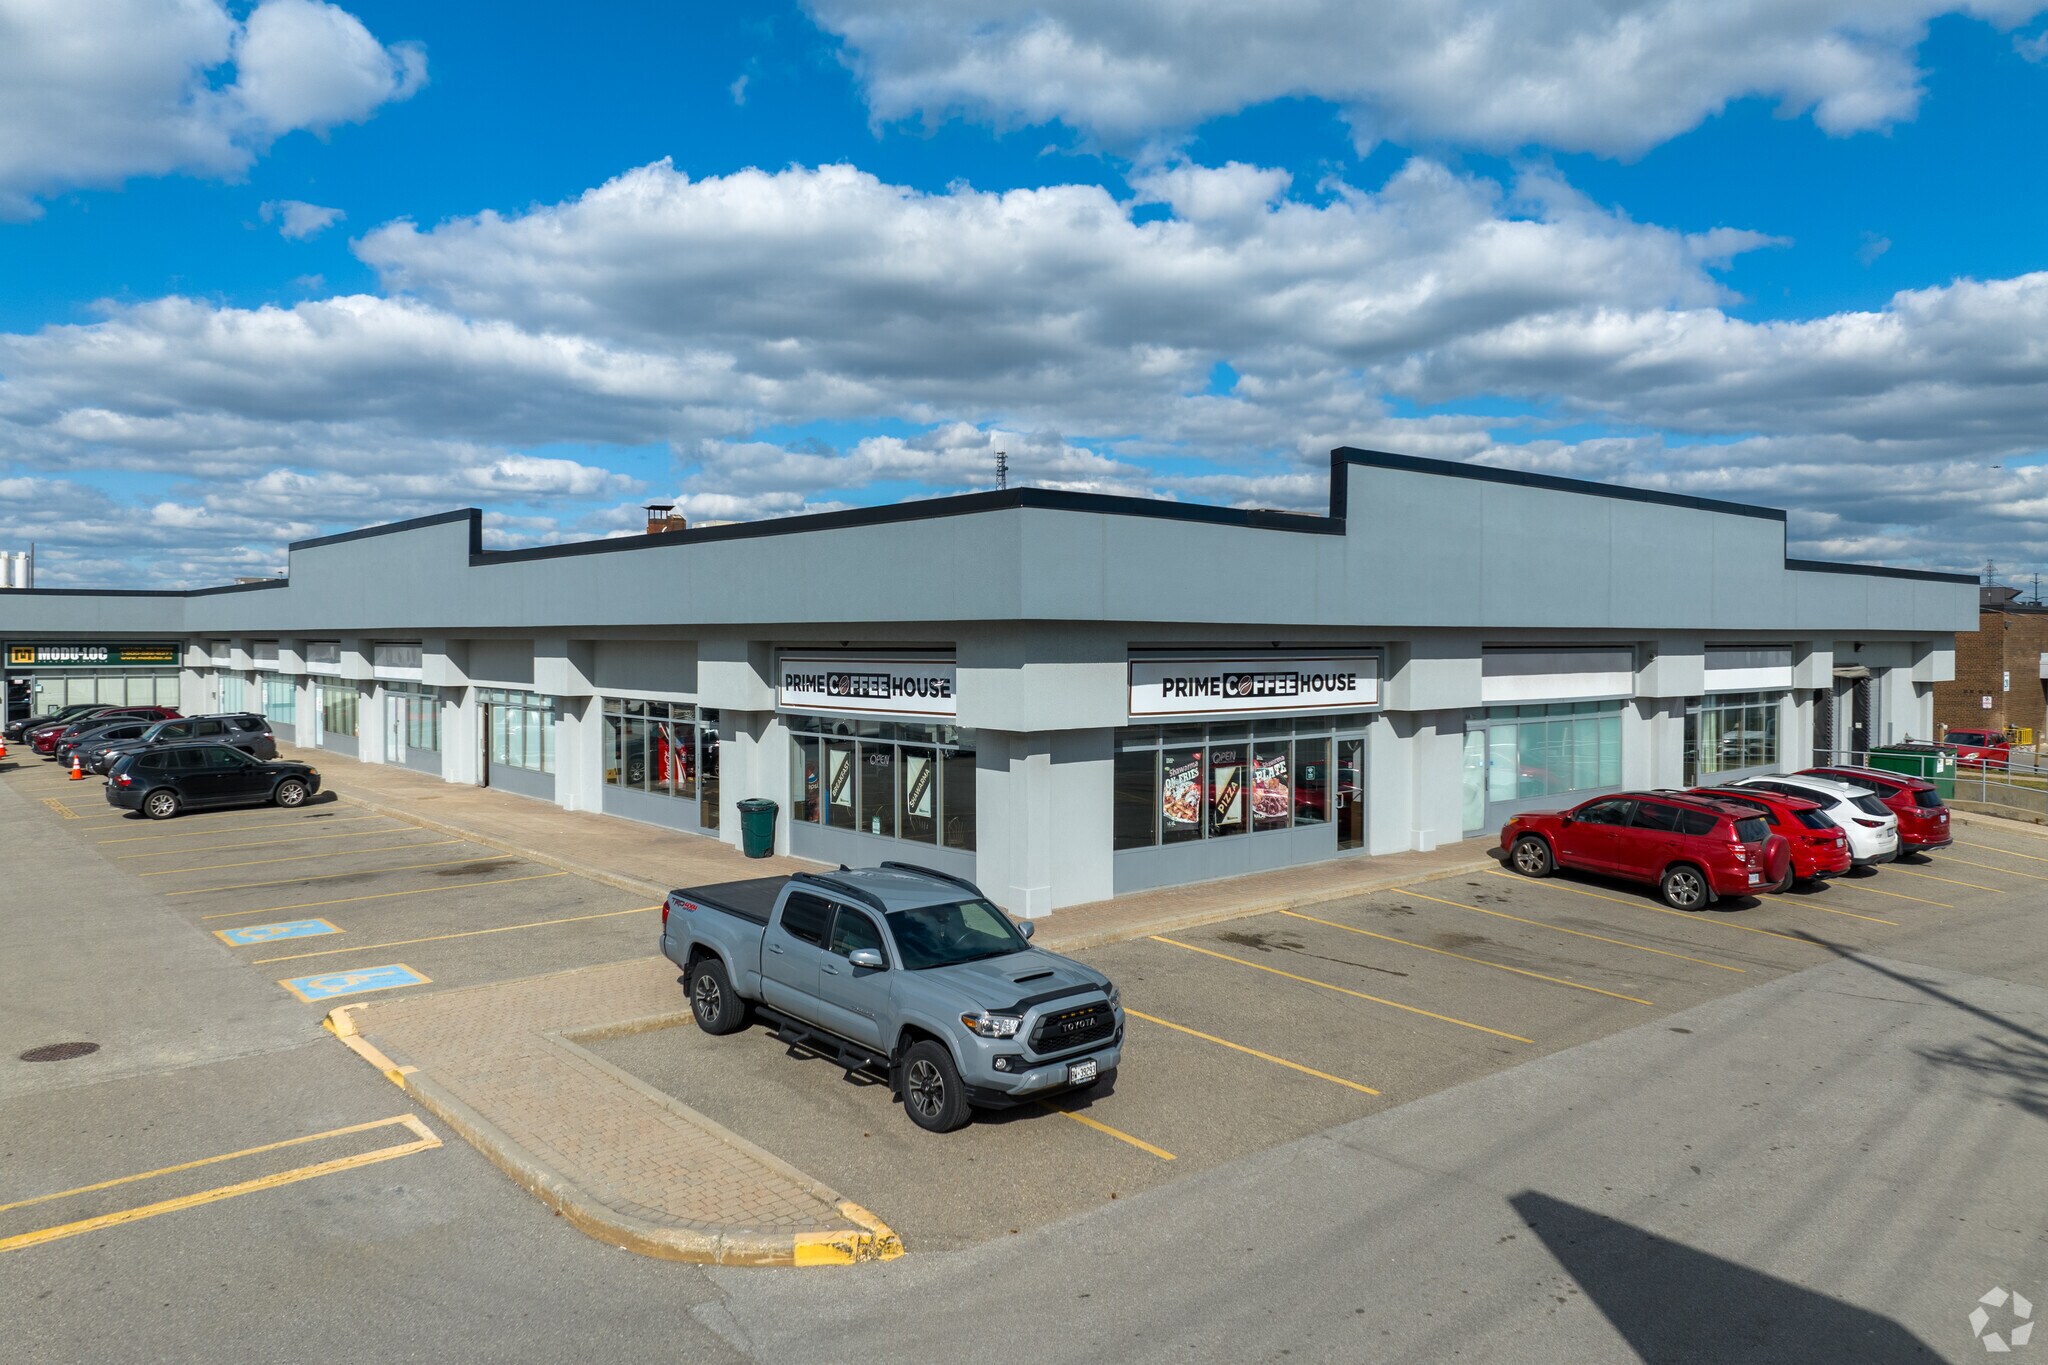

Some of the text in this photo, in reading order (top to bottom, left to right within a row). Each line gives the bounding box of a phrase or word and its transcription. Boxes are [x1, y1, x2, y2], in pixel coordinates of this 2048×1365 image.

[38, 647, 108, 660] MODU-LOC
[785, 673, 951, 698] PRIME COFFEE HOUSE
[1162, 673, 1356, 698] PRIME COFFEE HOUSE
[869, 754, 890, 766] OPEN
[1212, 751, 1236, 764] OPEN
[832, 760, 849, 797] BREAKFAST
[1169, 761, 1199, 777] Shawarma
[1255, 761, 1287, 783] PLATE
[909, 768, 930, 808] SHAWARMA
[1217, 781, 1238, 814] PIZZA
[1062, 1017, 1096, 1032] TOYOTA
